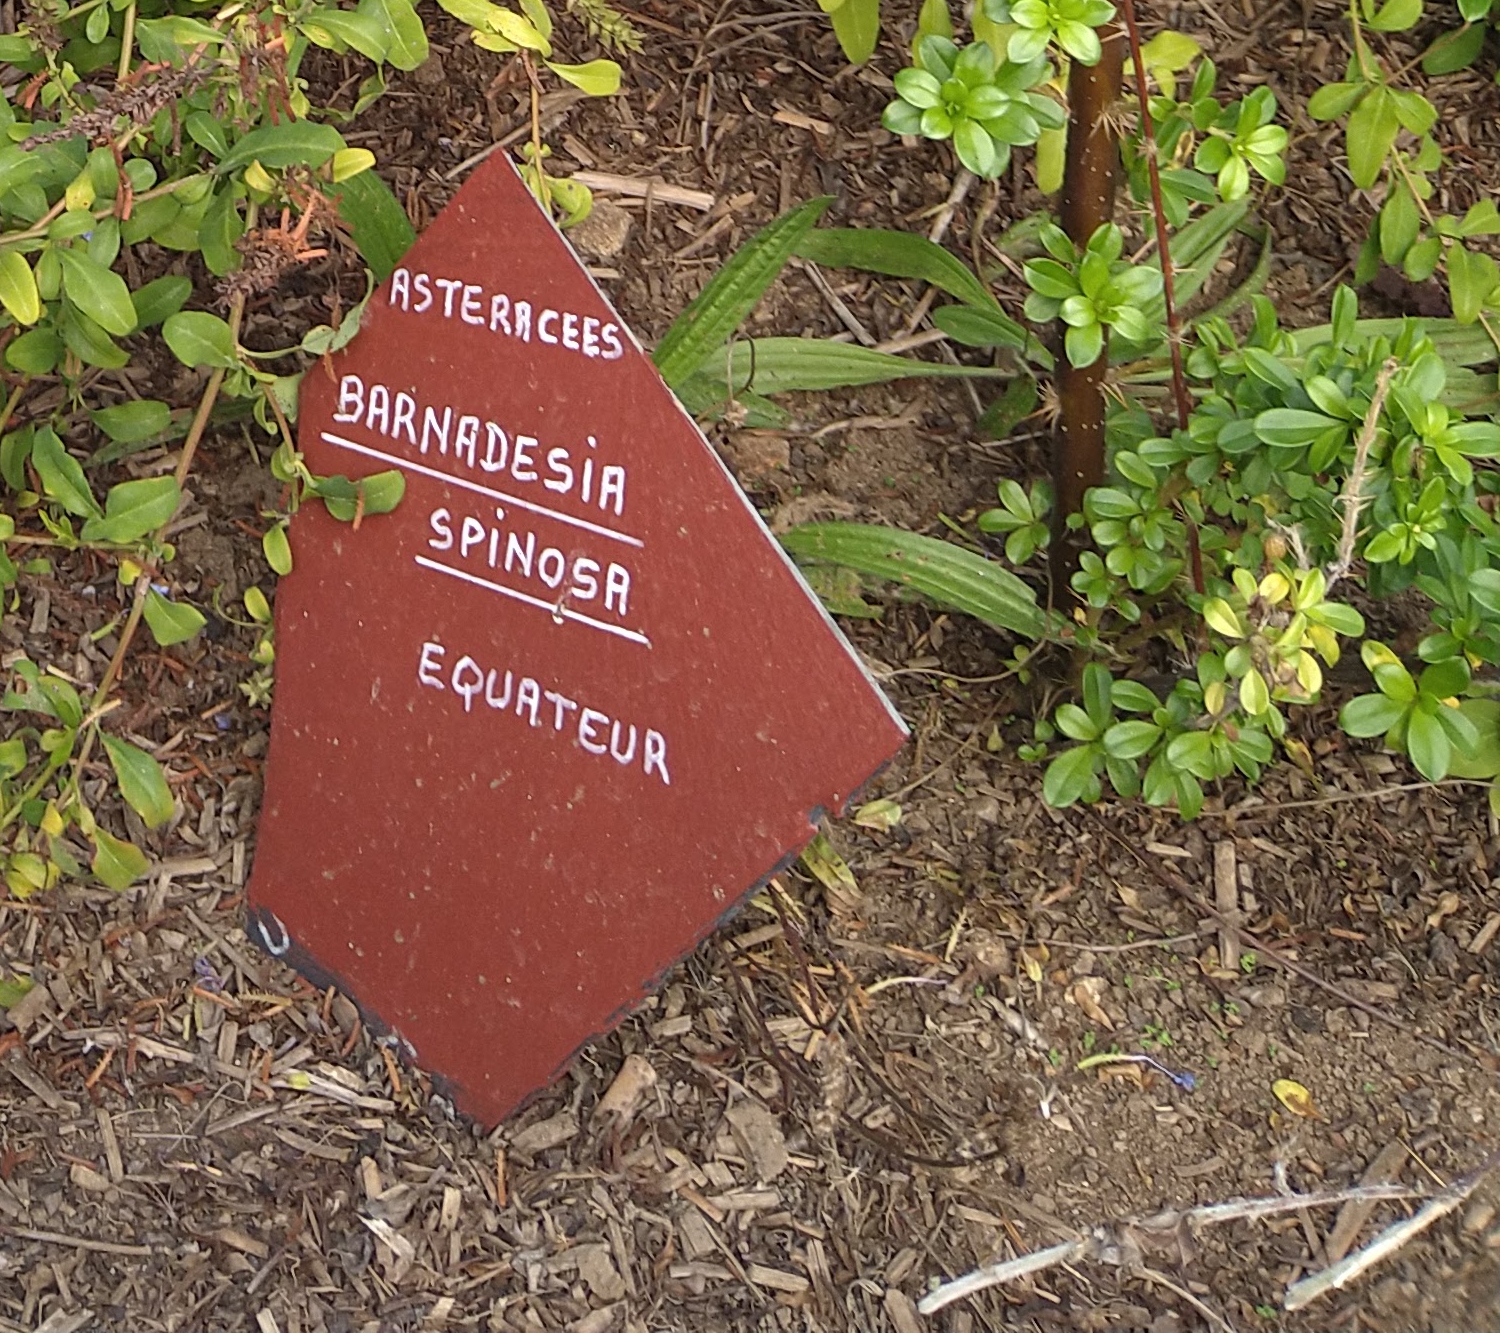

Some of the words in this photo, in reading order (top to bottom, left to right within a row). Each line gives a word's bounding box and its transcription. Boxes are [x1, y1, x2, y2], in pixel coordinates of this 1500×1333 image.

[390, 267, 624, 362] ASTERACEES
[333, 374, 626, 517] BARNADESIA
[428, 507, 631, 617] SPINOSA
[418, 641, 671, 786] EQUATEUR
